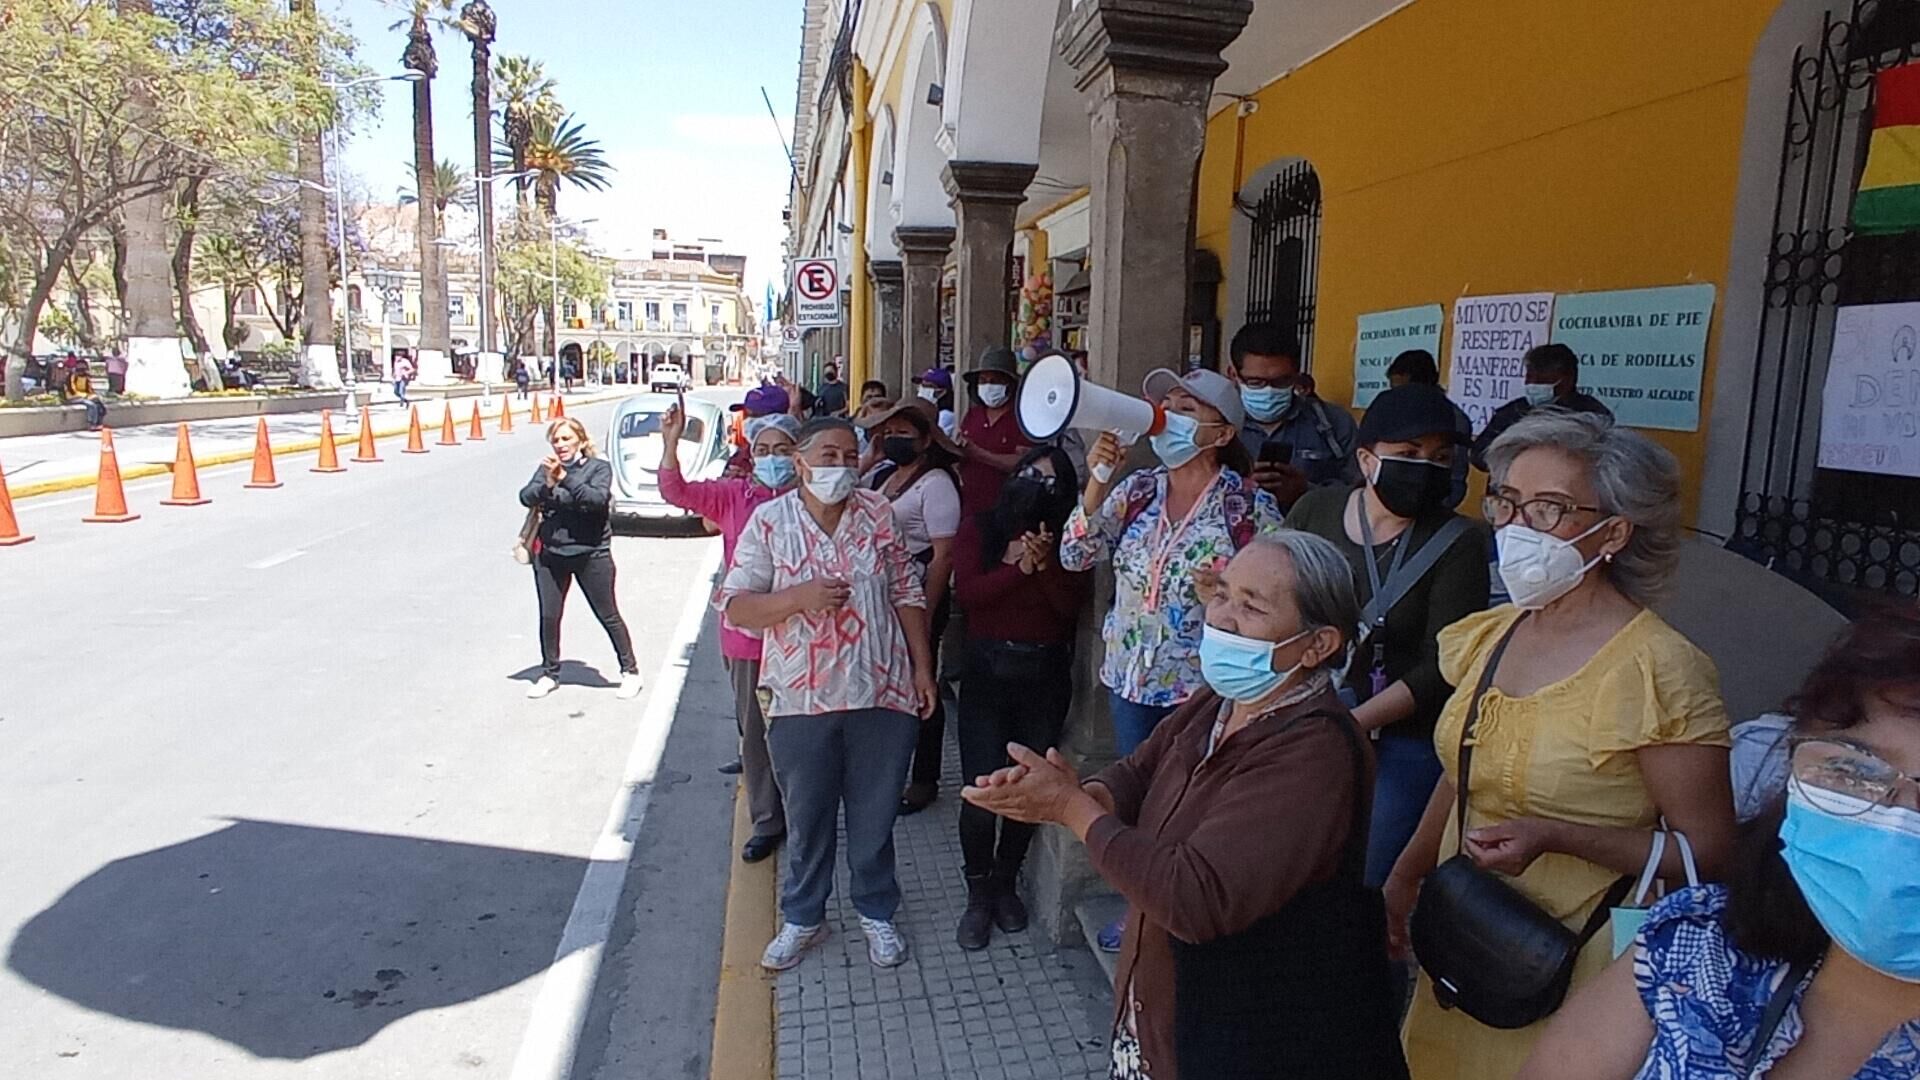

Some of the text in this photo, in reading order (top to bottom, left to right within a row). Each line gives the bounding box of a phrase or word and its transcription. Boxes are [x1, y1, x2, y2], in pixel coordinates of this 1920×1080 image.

[808, 269, 825, 292] E
[801, 303, 835, 311] PROHIBIDO
[1456, 301, 1548, 325] MI VOTO SE
[799, 313, 838, 321] ESTACIONAR
[1559, 312, 1703, 330] COCHABAMBA DE PIE
[1409, 325, 1420, 336] DE
[1424, 323, 1437, 335] PIE
[1461, 330, 1534, 351] RESPETA
[1601, 354, 1620, 367] DE
[1624, 354, 1696, 368] RODILLAS
[1464, 378, 1510, 400] ES MI
[1597, 386, 1643, 399] NUESTRO
[1647, 388, 1696, 401] ALCALDE
